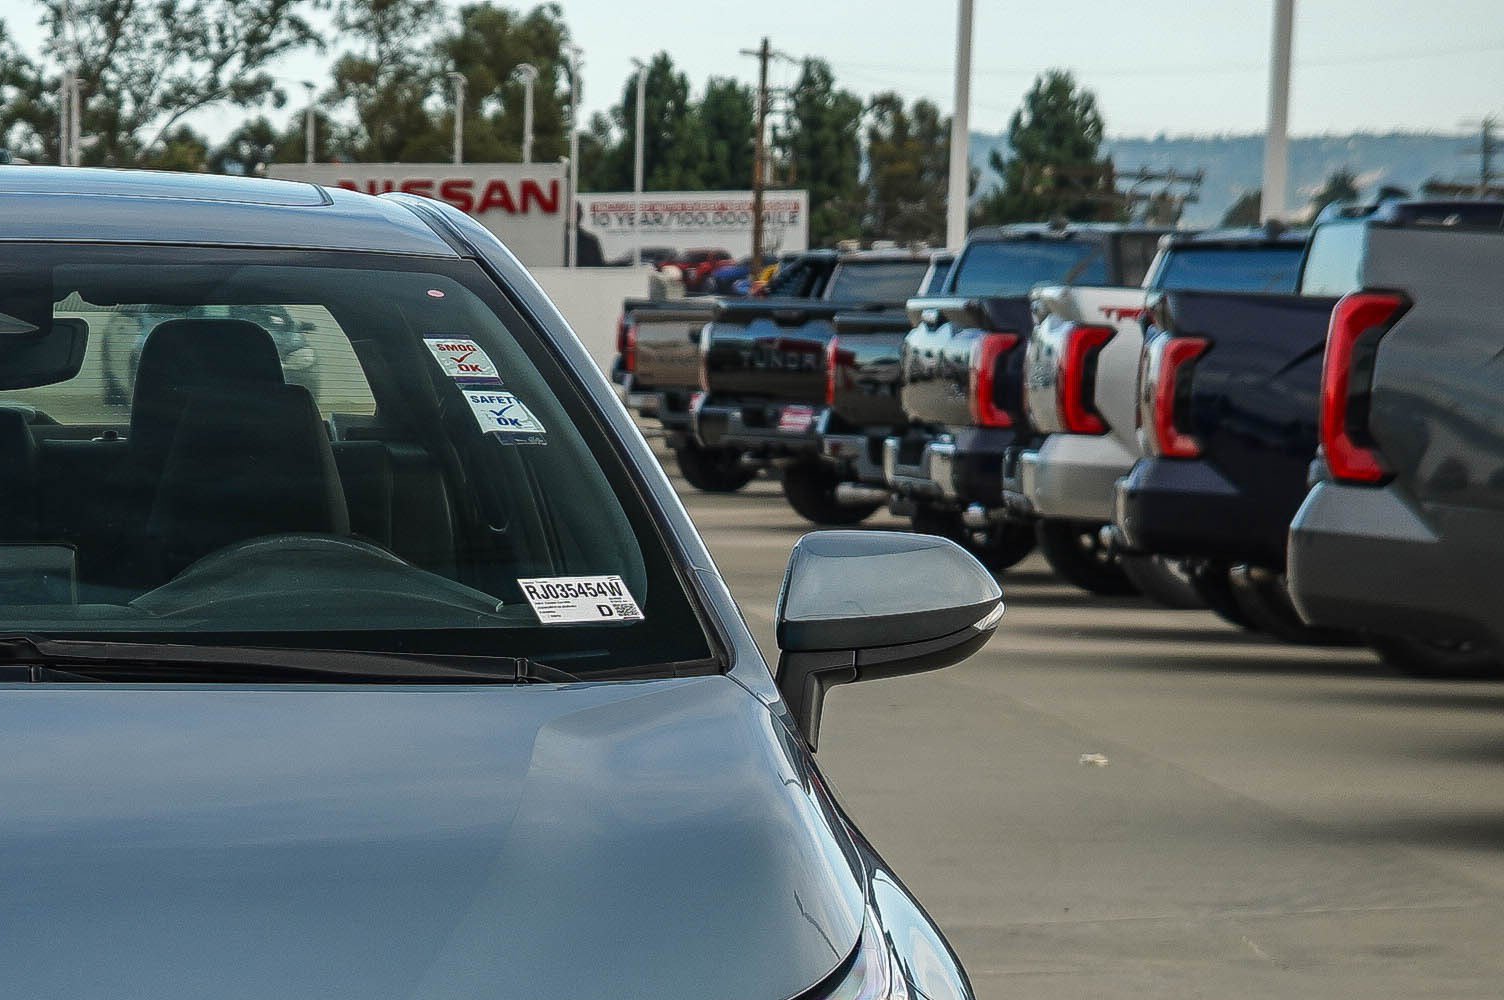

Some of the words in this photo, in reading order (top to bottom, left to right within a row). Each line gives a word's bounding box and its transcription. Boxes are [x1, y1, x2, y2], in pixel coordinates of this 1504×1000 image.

[457, 363, 483, 372] OK
[496, 417, 523, 426] OK
[524, 581, 624, 600] RJ035454W
[596, 604, 614, 617] D
